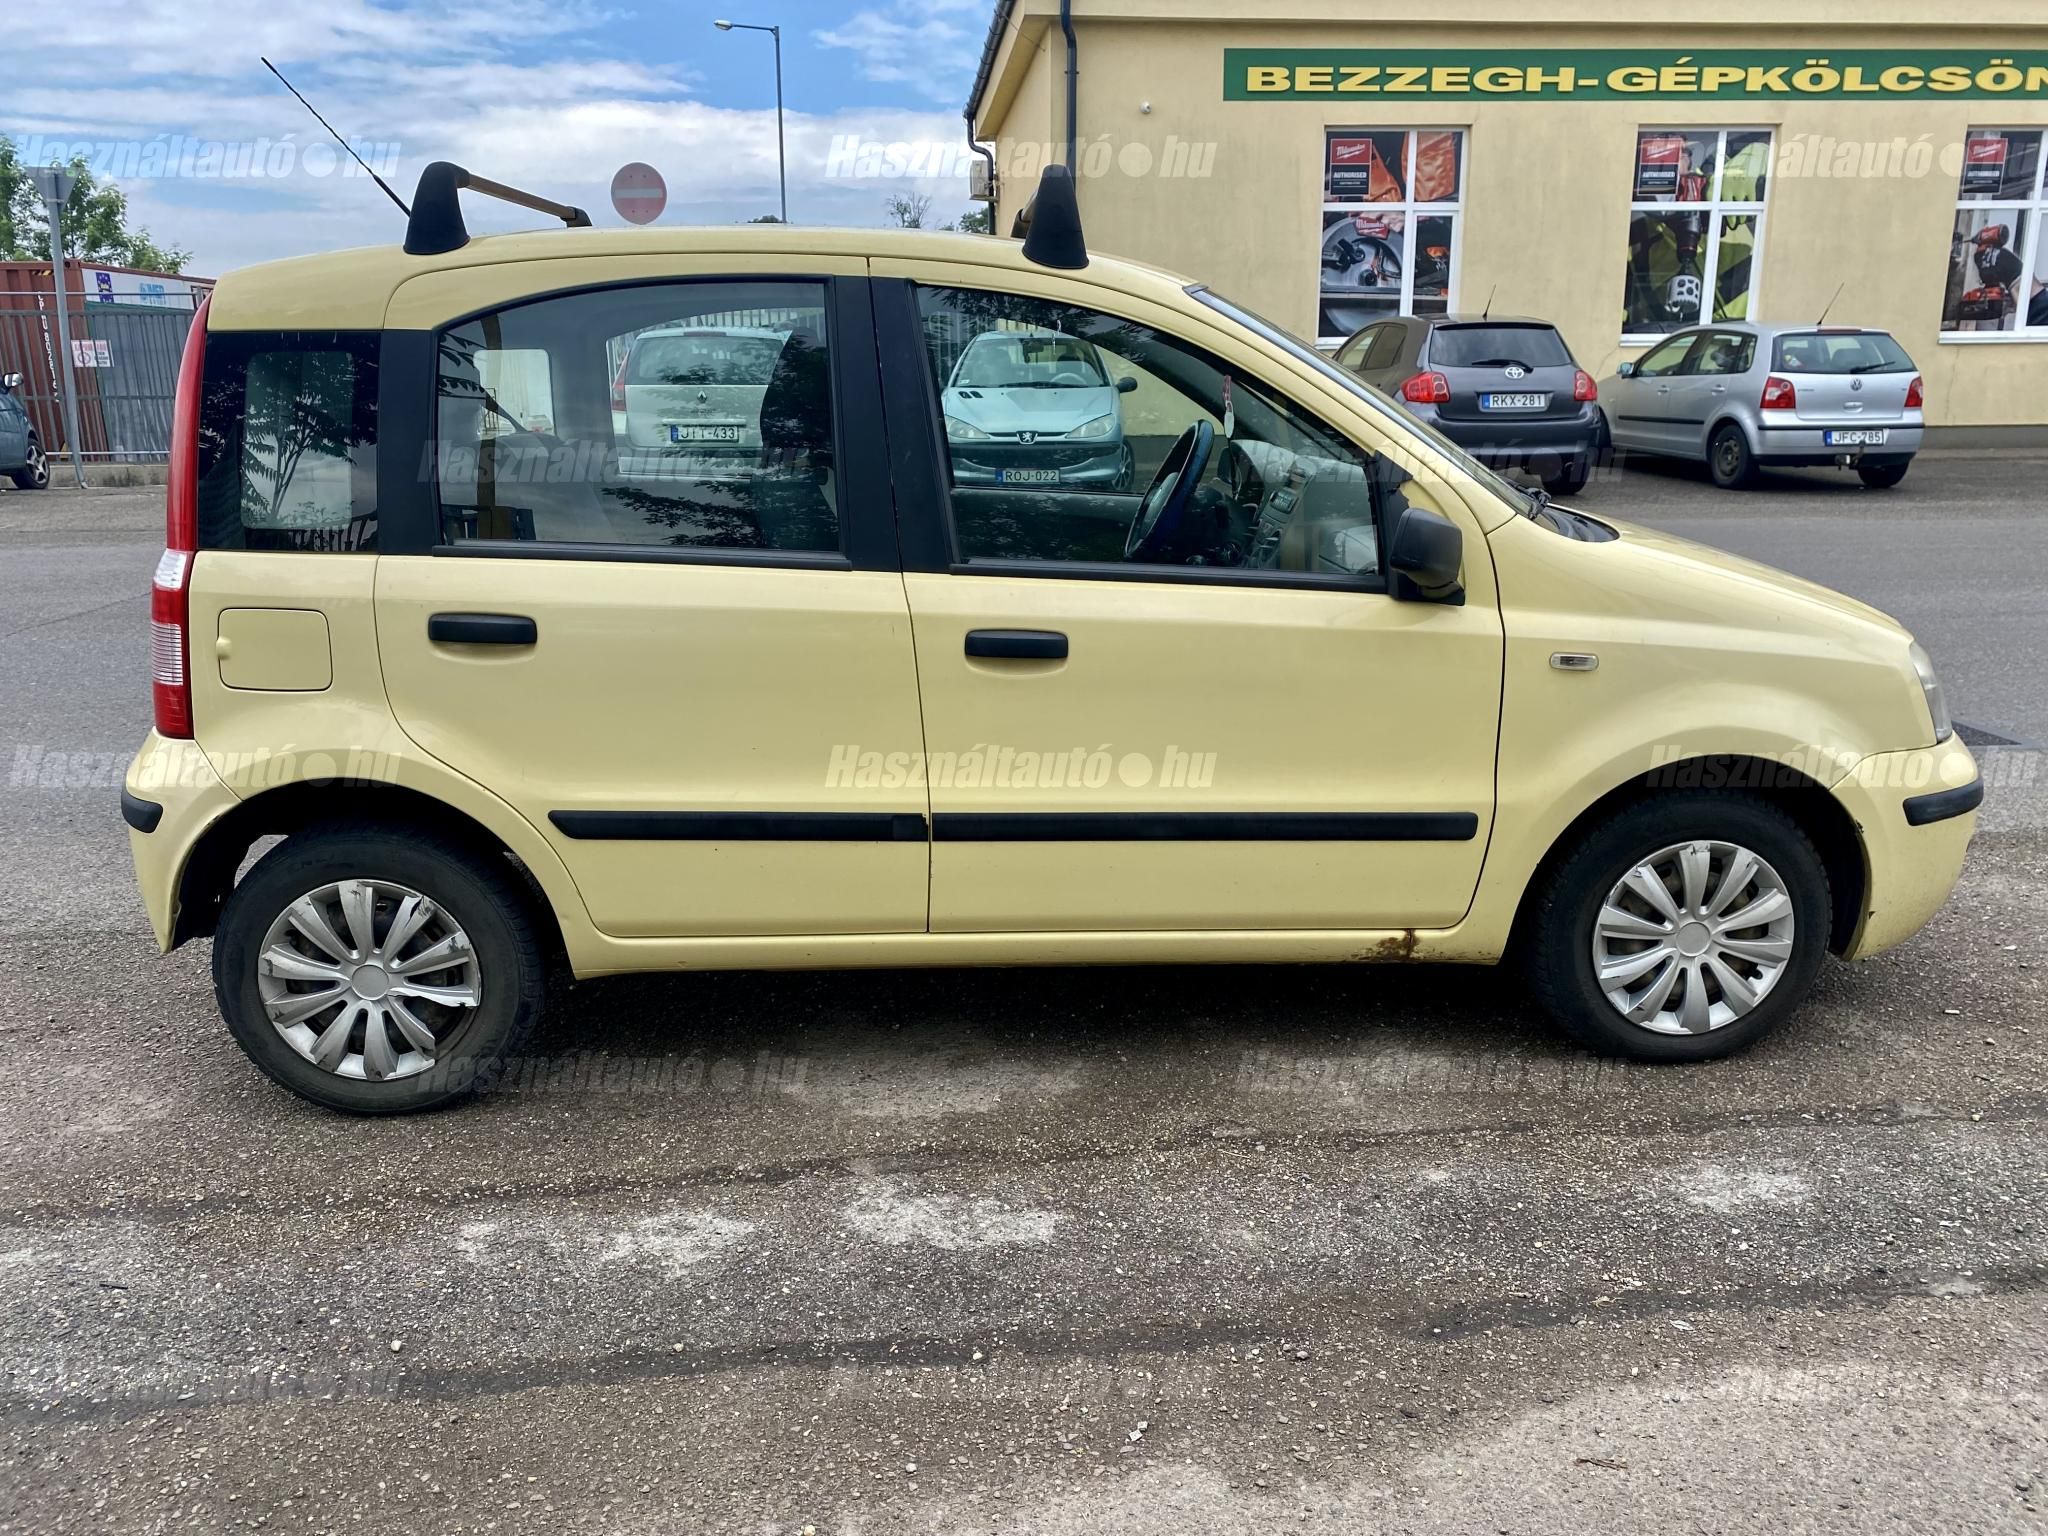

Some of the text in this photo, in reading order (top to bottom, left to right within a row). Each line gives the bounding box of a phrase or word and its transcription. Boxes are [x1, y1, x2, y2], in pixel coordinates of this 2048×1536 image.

[1492, 394, 1543, 407] RKX-281
[680, 427, 735, 439] JIT-433
[1834, 431, 1881, 443] JFC-785
[1005, 471, 1057, 481] ROJ-022
